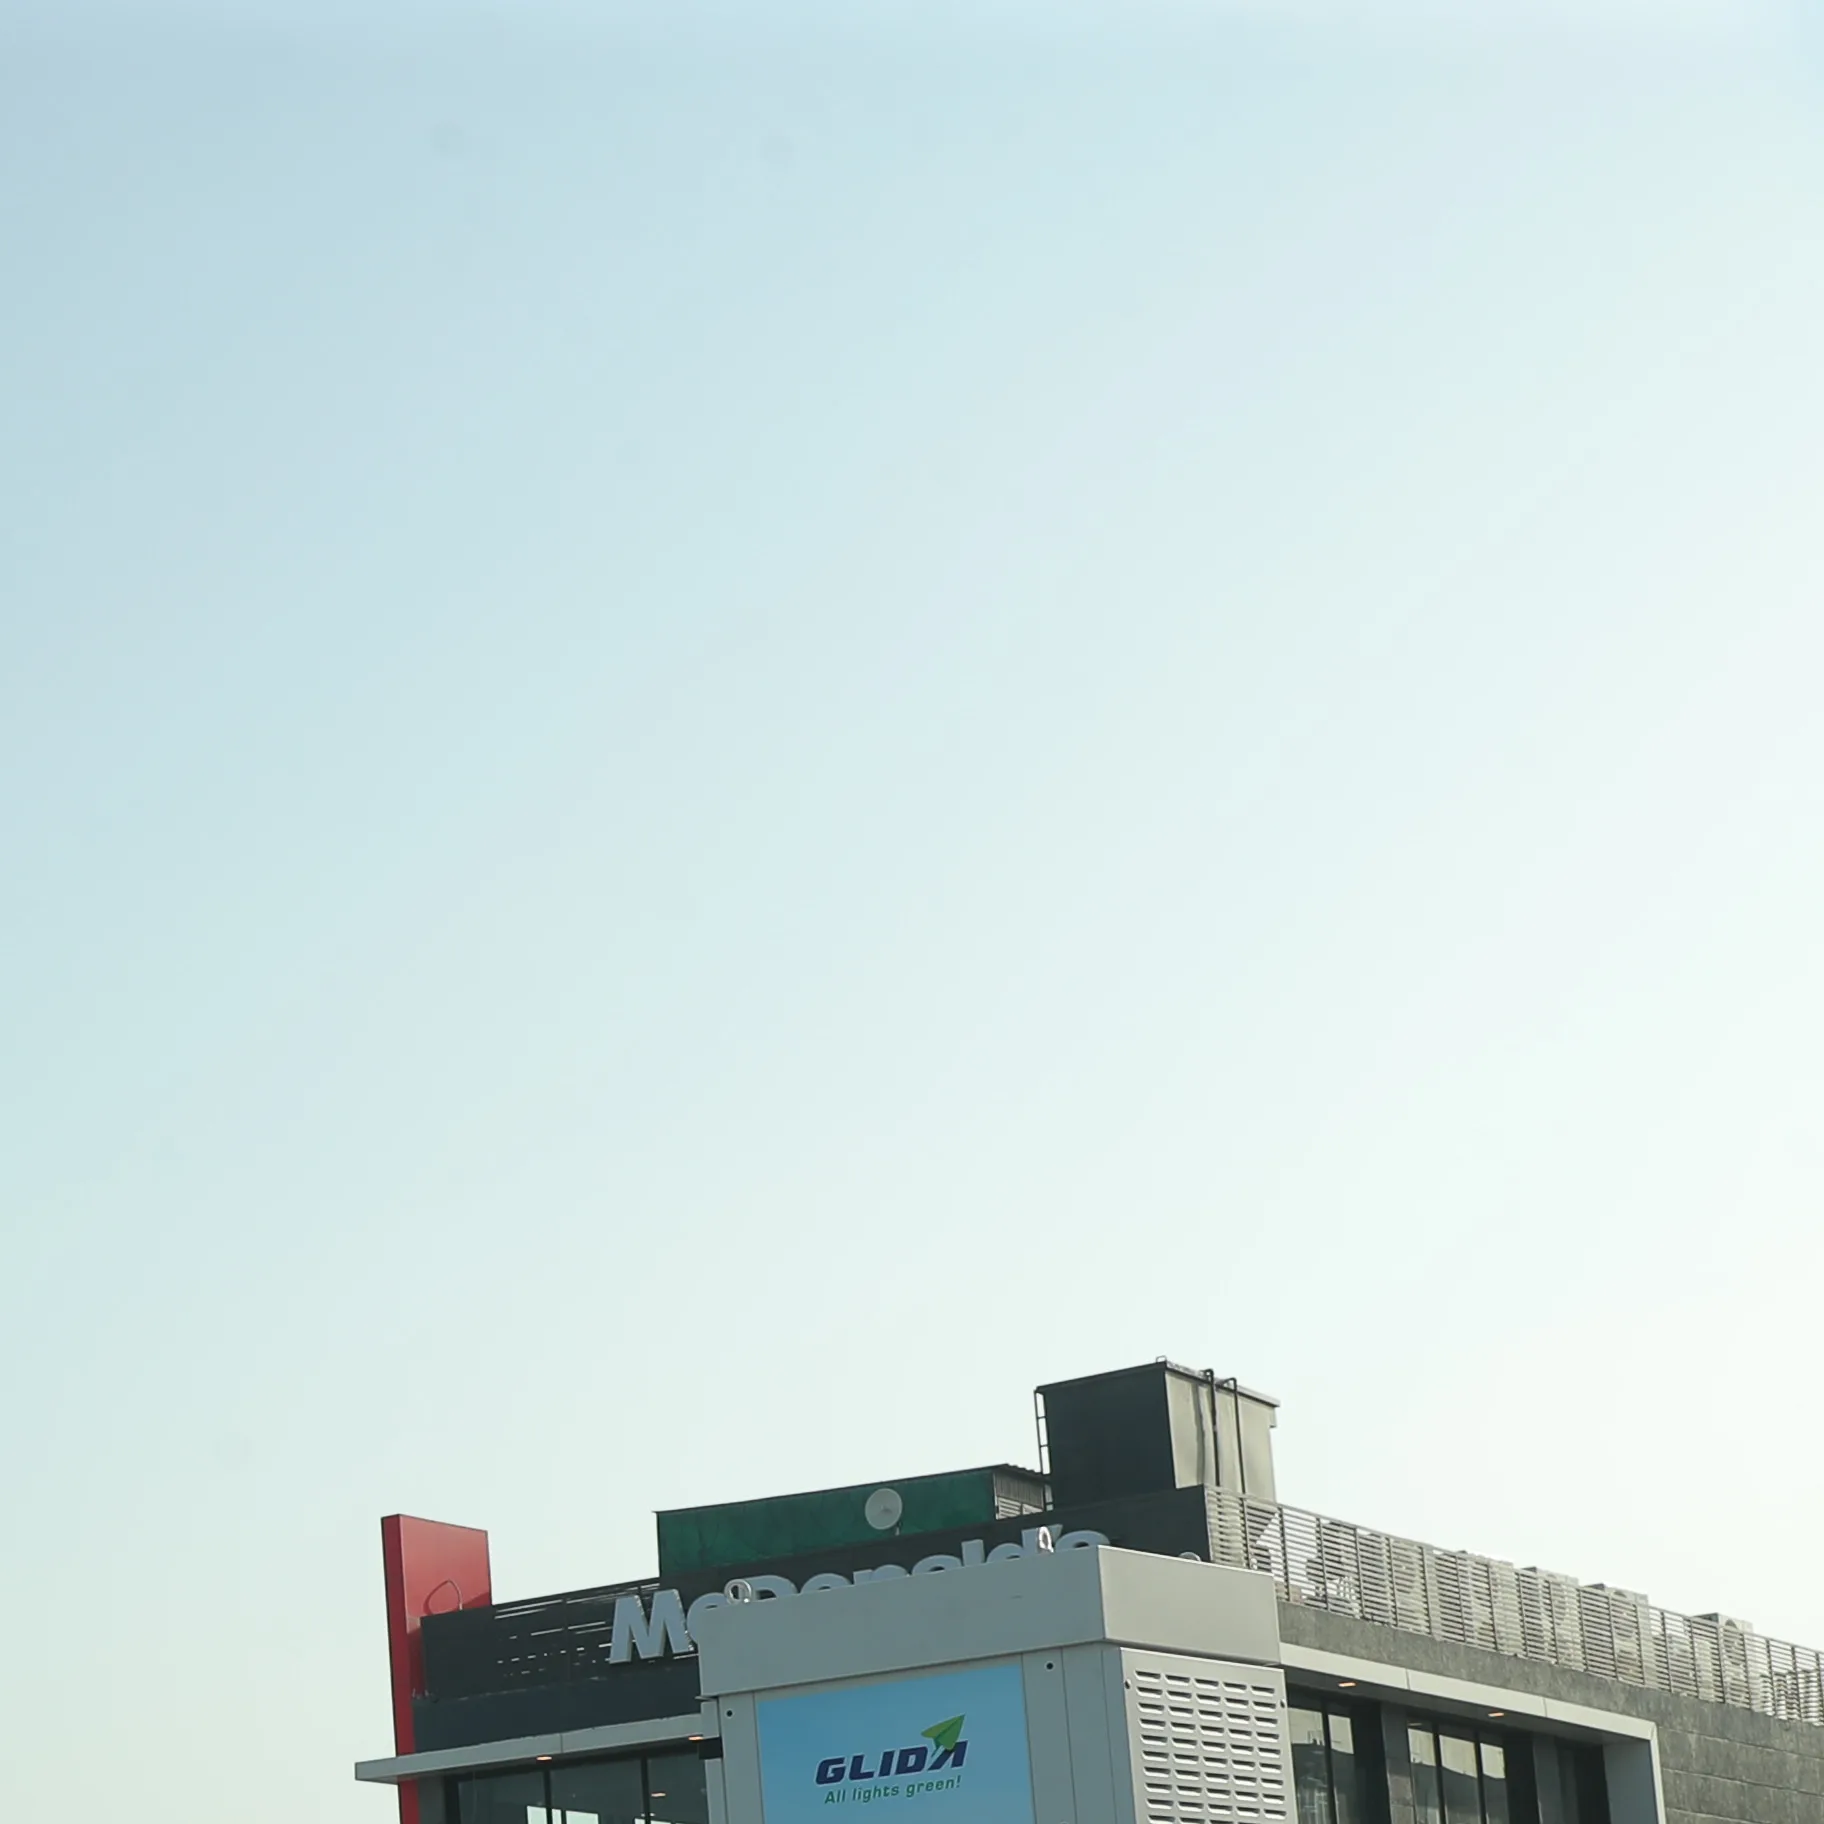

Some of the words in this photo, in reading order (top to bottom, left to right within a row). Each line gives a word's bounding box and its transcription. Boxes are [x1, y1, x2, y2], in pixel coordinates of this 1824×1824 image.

[815, 1740, 969, 1786] GLIDA
[824, 1789, 847, 1805] All
[852, 1785, 900, 1803] lights
[905, 1774, 962, 1798] green!
